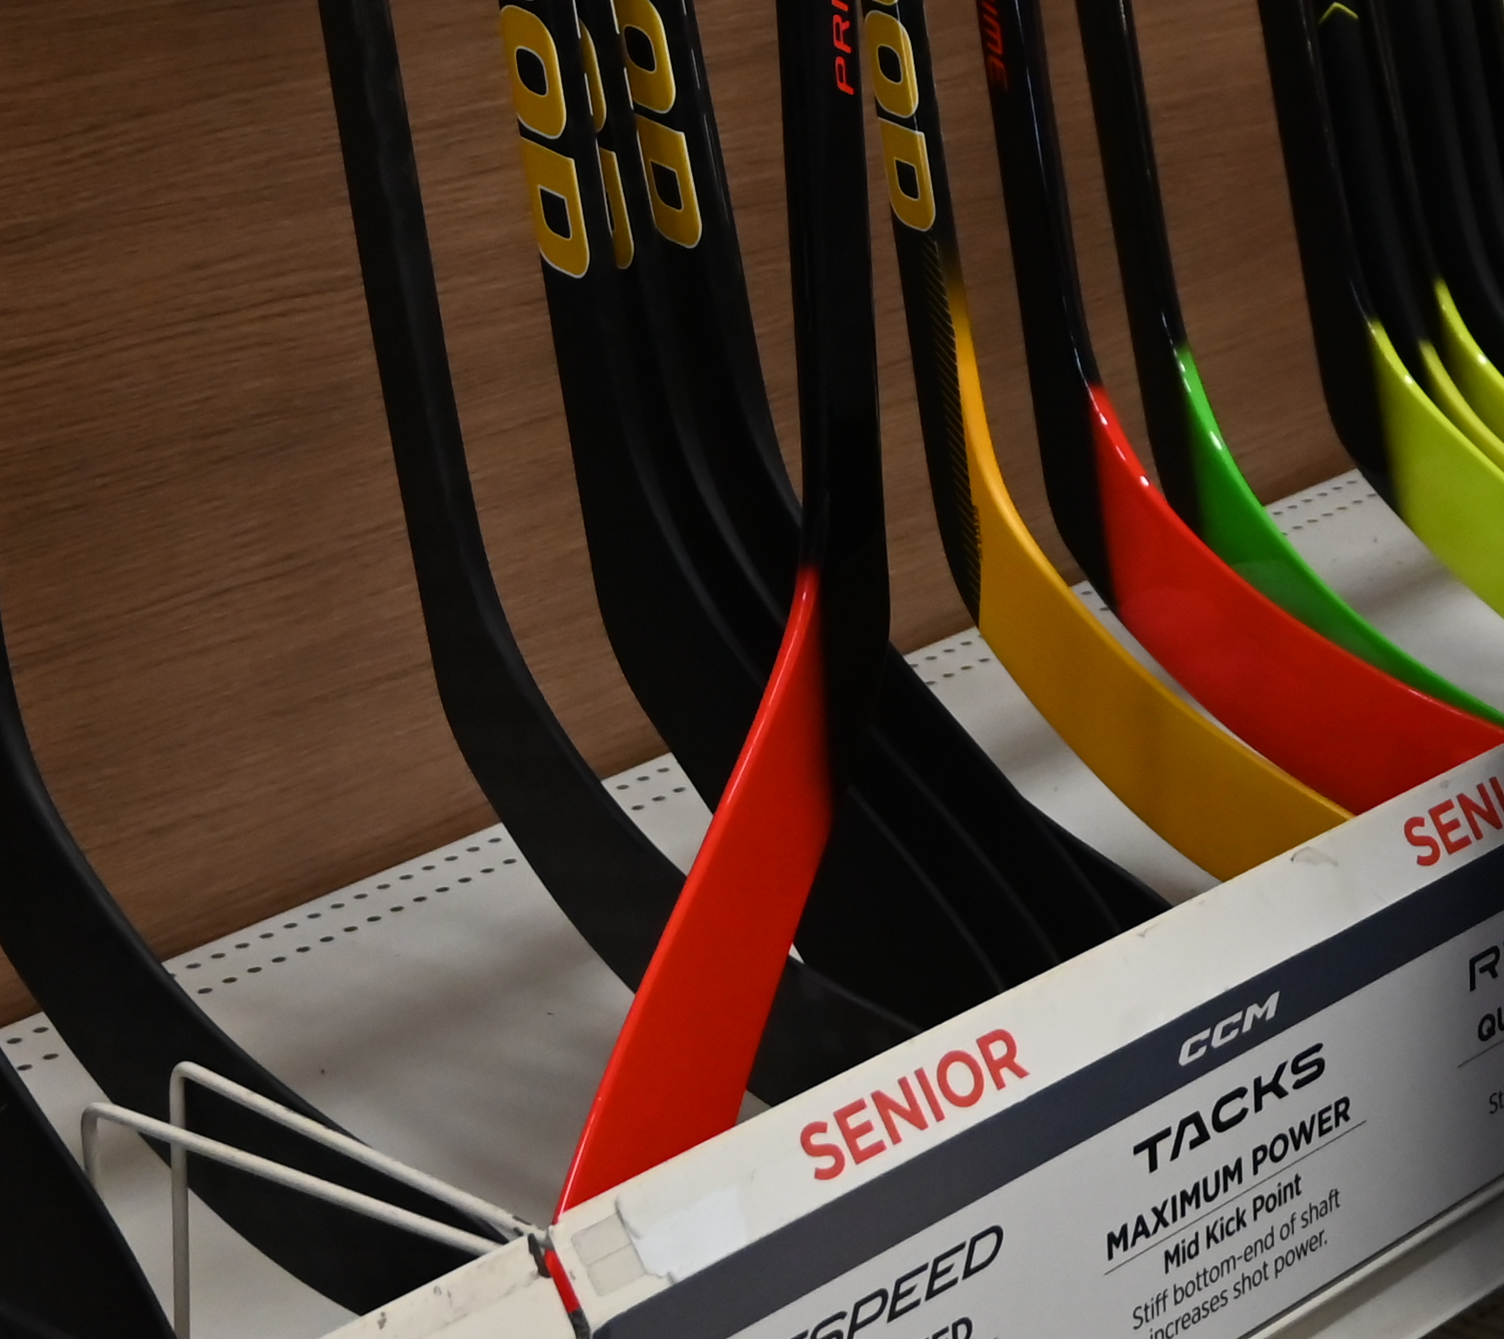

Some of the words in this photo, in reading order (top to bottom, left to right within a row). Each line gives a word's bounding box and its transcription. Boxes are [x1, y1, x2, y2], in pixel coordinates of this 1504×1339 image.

[1179, 991, 1280, 1066] CCM
[798, 1027, 1029, 1184] SENIOR
[1133, 1043, 1326, 1173] TACKS
[1106, 1157, 1244, 1261] MAXIMUM
[1252, 1096, 1352, 1178] POWER
[1163, 1238, 1199, 1274] Mid
[1205, 1208, 1247, 1249] Kick
[1252, 1173, 1303, 1222] Point
[1132, 1292, 1168, 1330] Stiff
[1172, 1230, 1276, 1306] bottom-end
[1279, 1213, 1298, 1243] of
[1300, 1188, 1341, 1229] shaft
[1233, 1266, 1270, 1302] shot
[1274, 1230, 1329, 1279] power.
